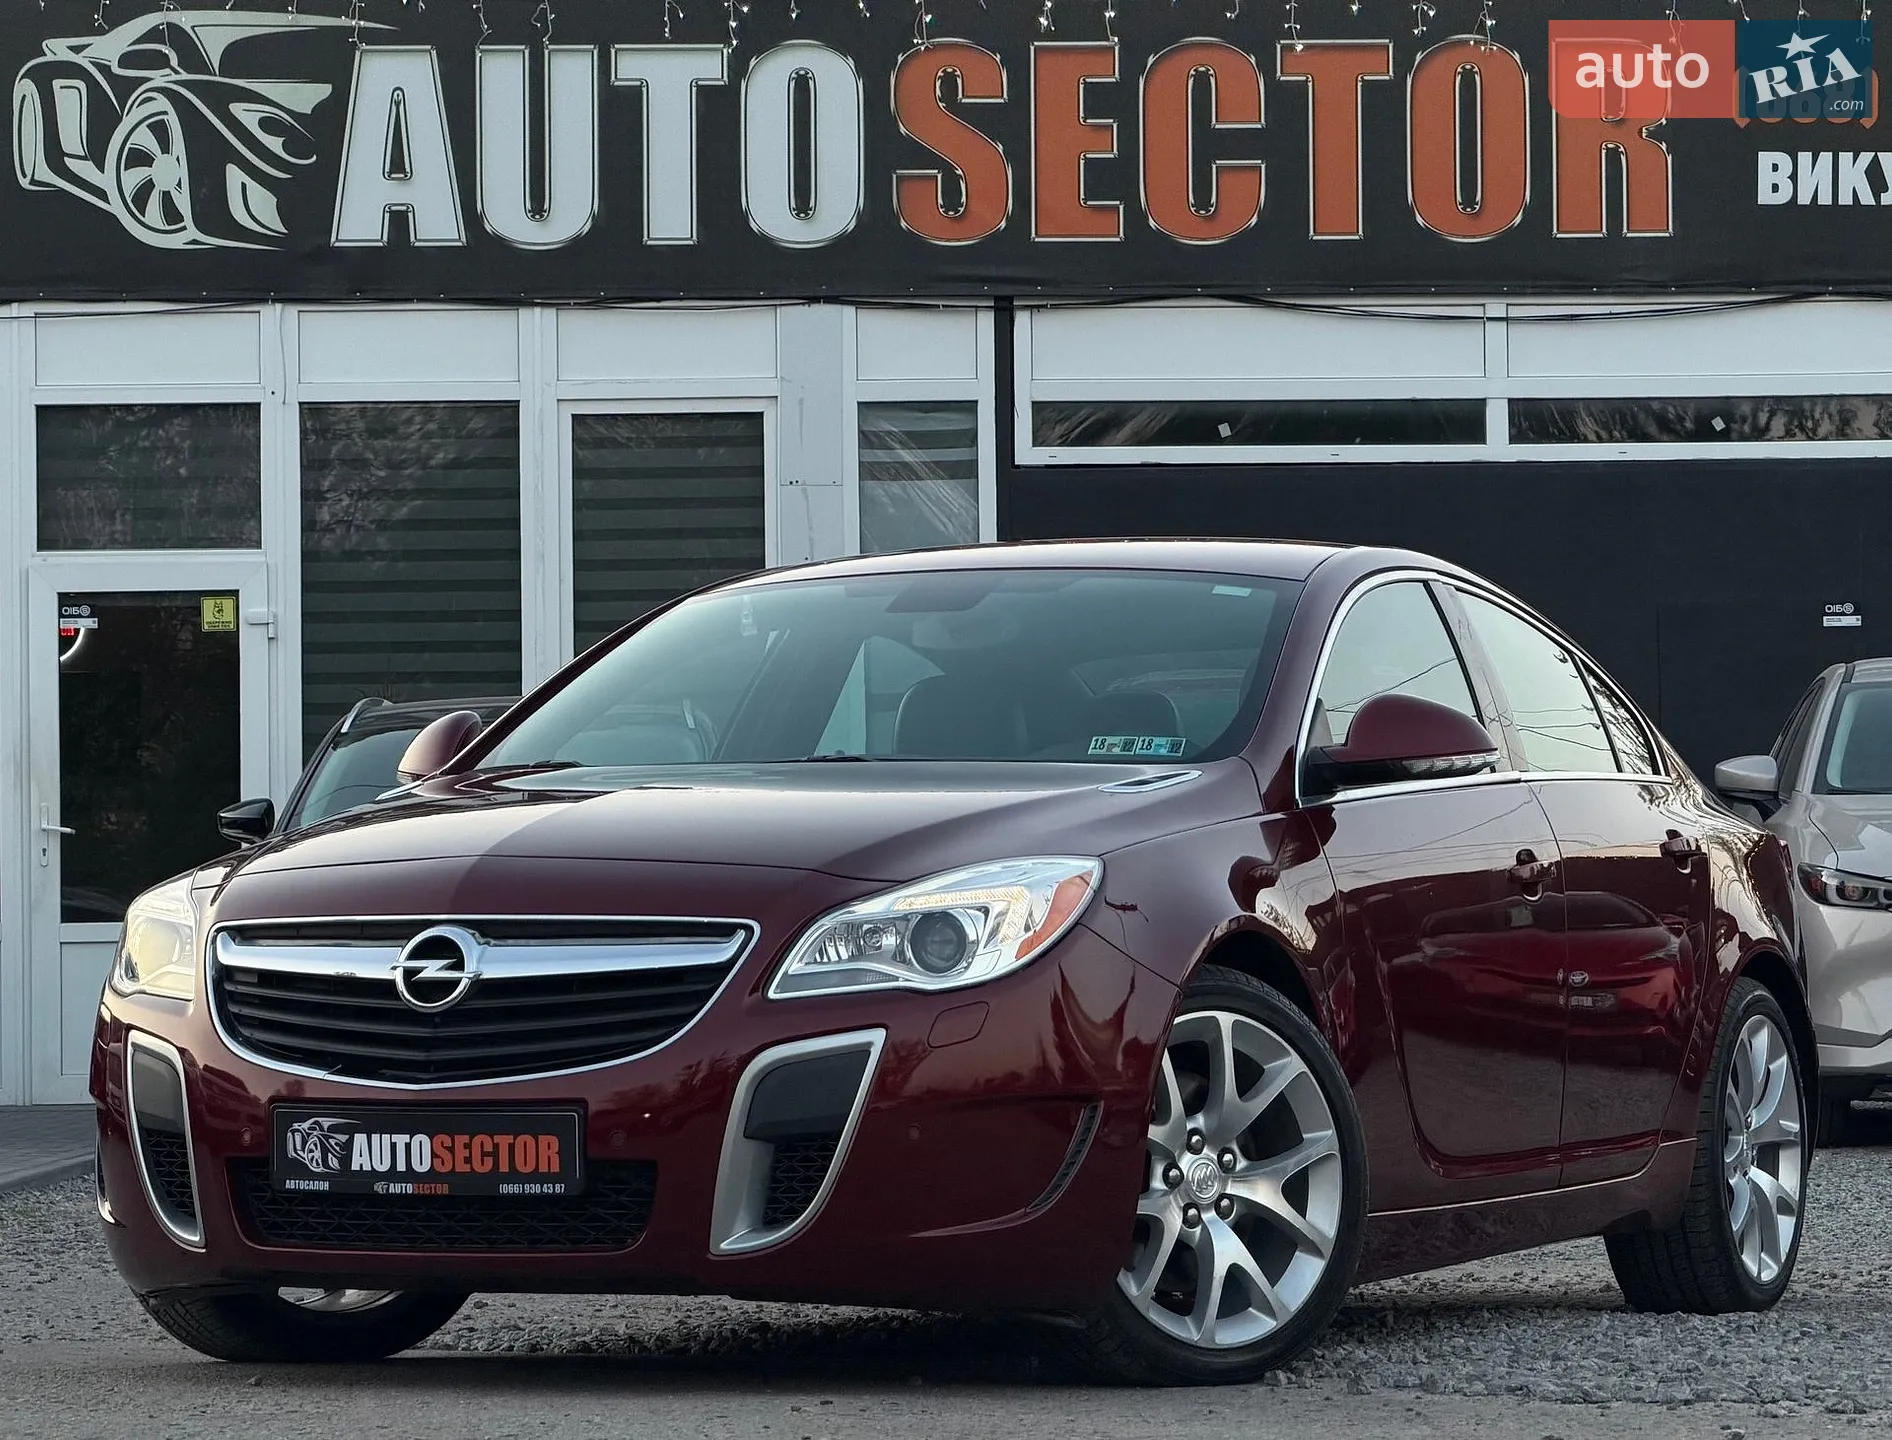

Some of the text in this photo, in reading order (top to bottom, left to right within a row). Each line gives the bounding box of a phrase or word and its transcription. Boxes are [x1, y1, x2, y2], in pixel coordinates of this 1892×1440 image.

[331, 38, 1674, 249] AUTOSECTOR
[1091, 738, 1107, 751] 18
[1138, 738, 1154, 751] 18
[351, 1133, 561, 1173] AUTOSECTOR
[285, 1179, 330, 1191] АВТОСАЛОН
[388, 1182, 450, 1195] AUTOSECTOR
[499, 1183, 566, 1194] (066) 930 43 87
